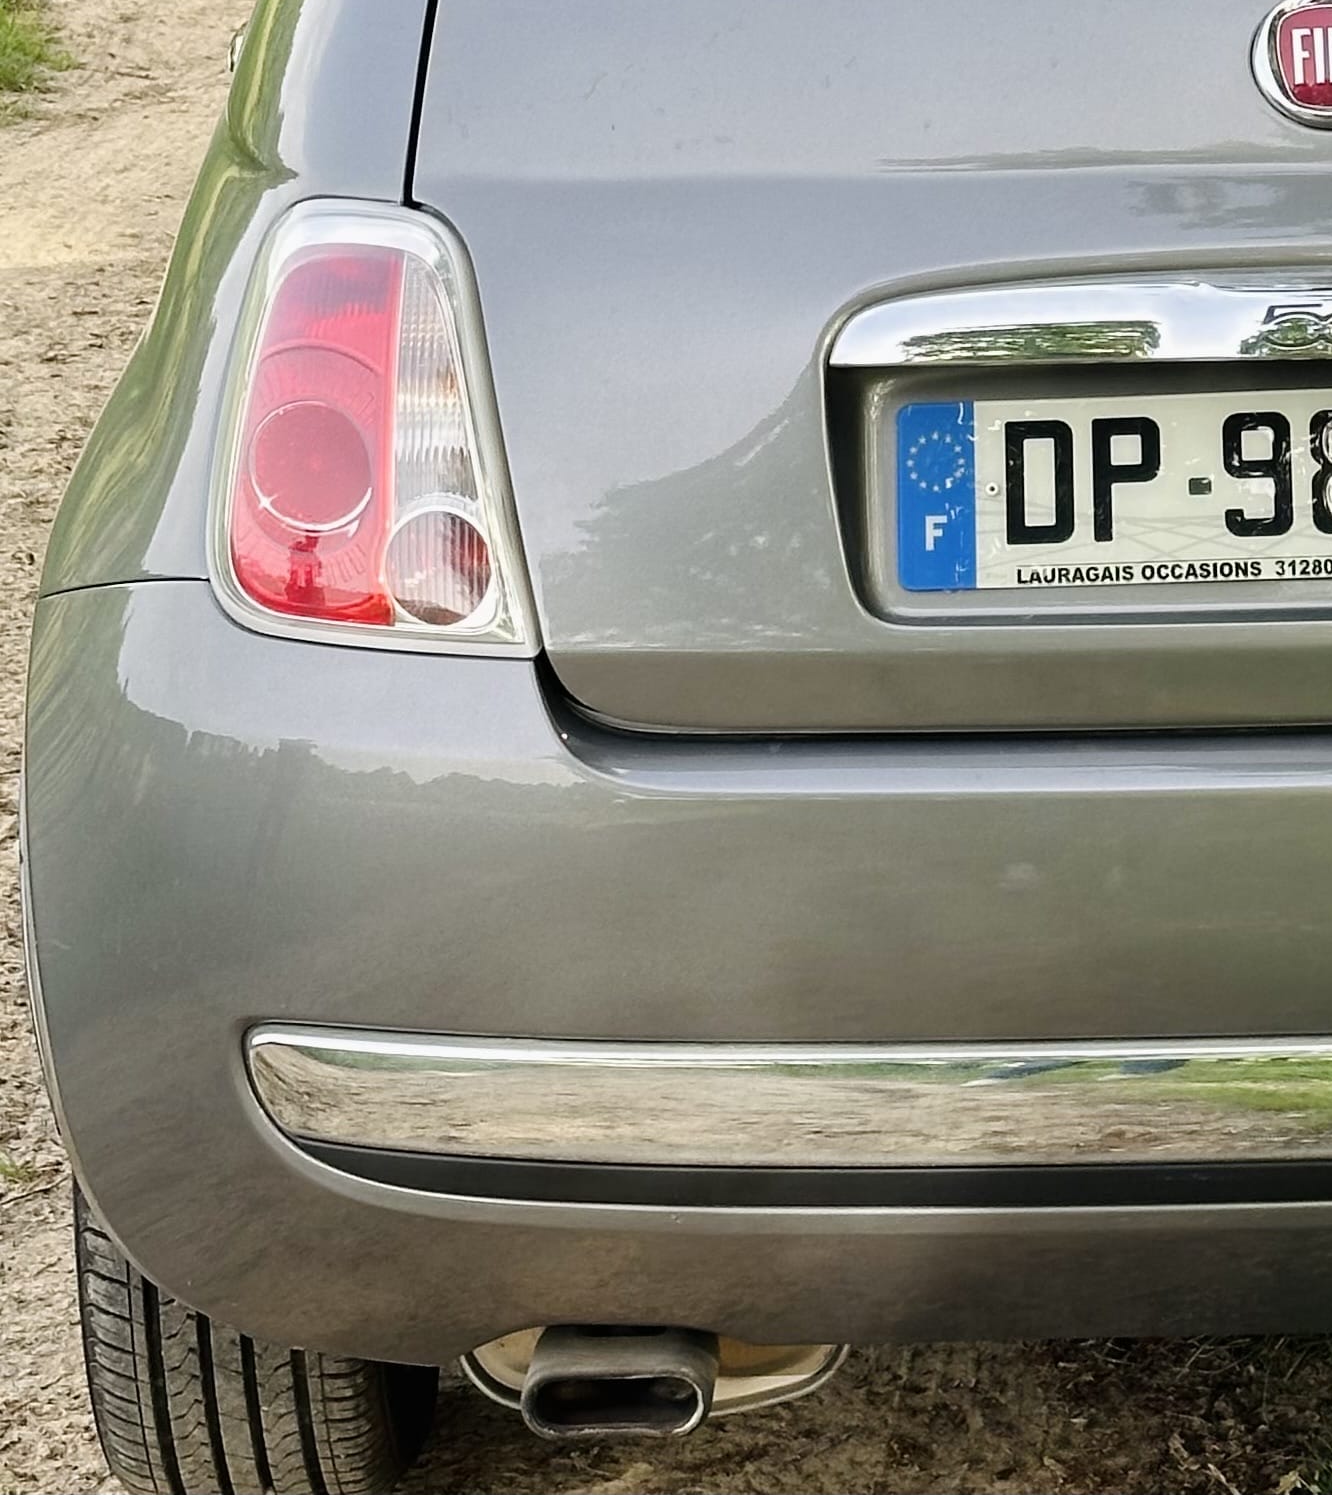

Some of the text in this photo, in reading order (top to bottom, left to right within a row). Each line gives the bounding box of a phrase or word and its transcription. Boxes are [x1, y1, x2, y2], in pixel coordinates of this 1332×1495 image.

[925, 515, 948, 552] F
[1016, 565, 1134, 585] LAURAGAIS
[1141, 560, 1262, 581] OCCASIONS
